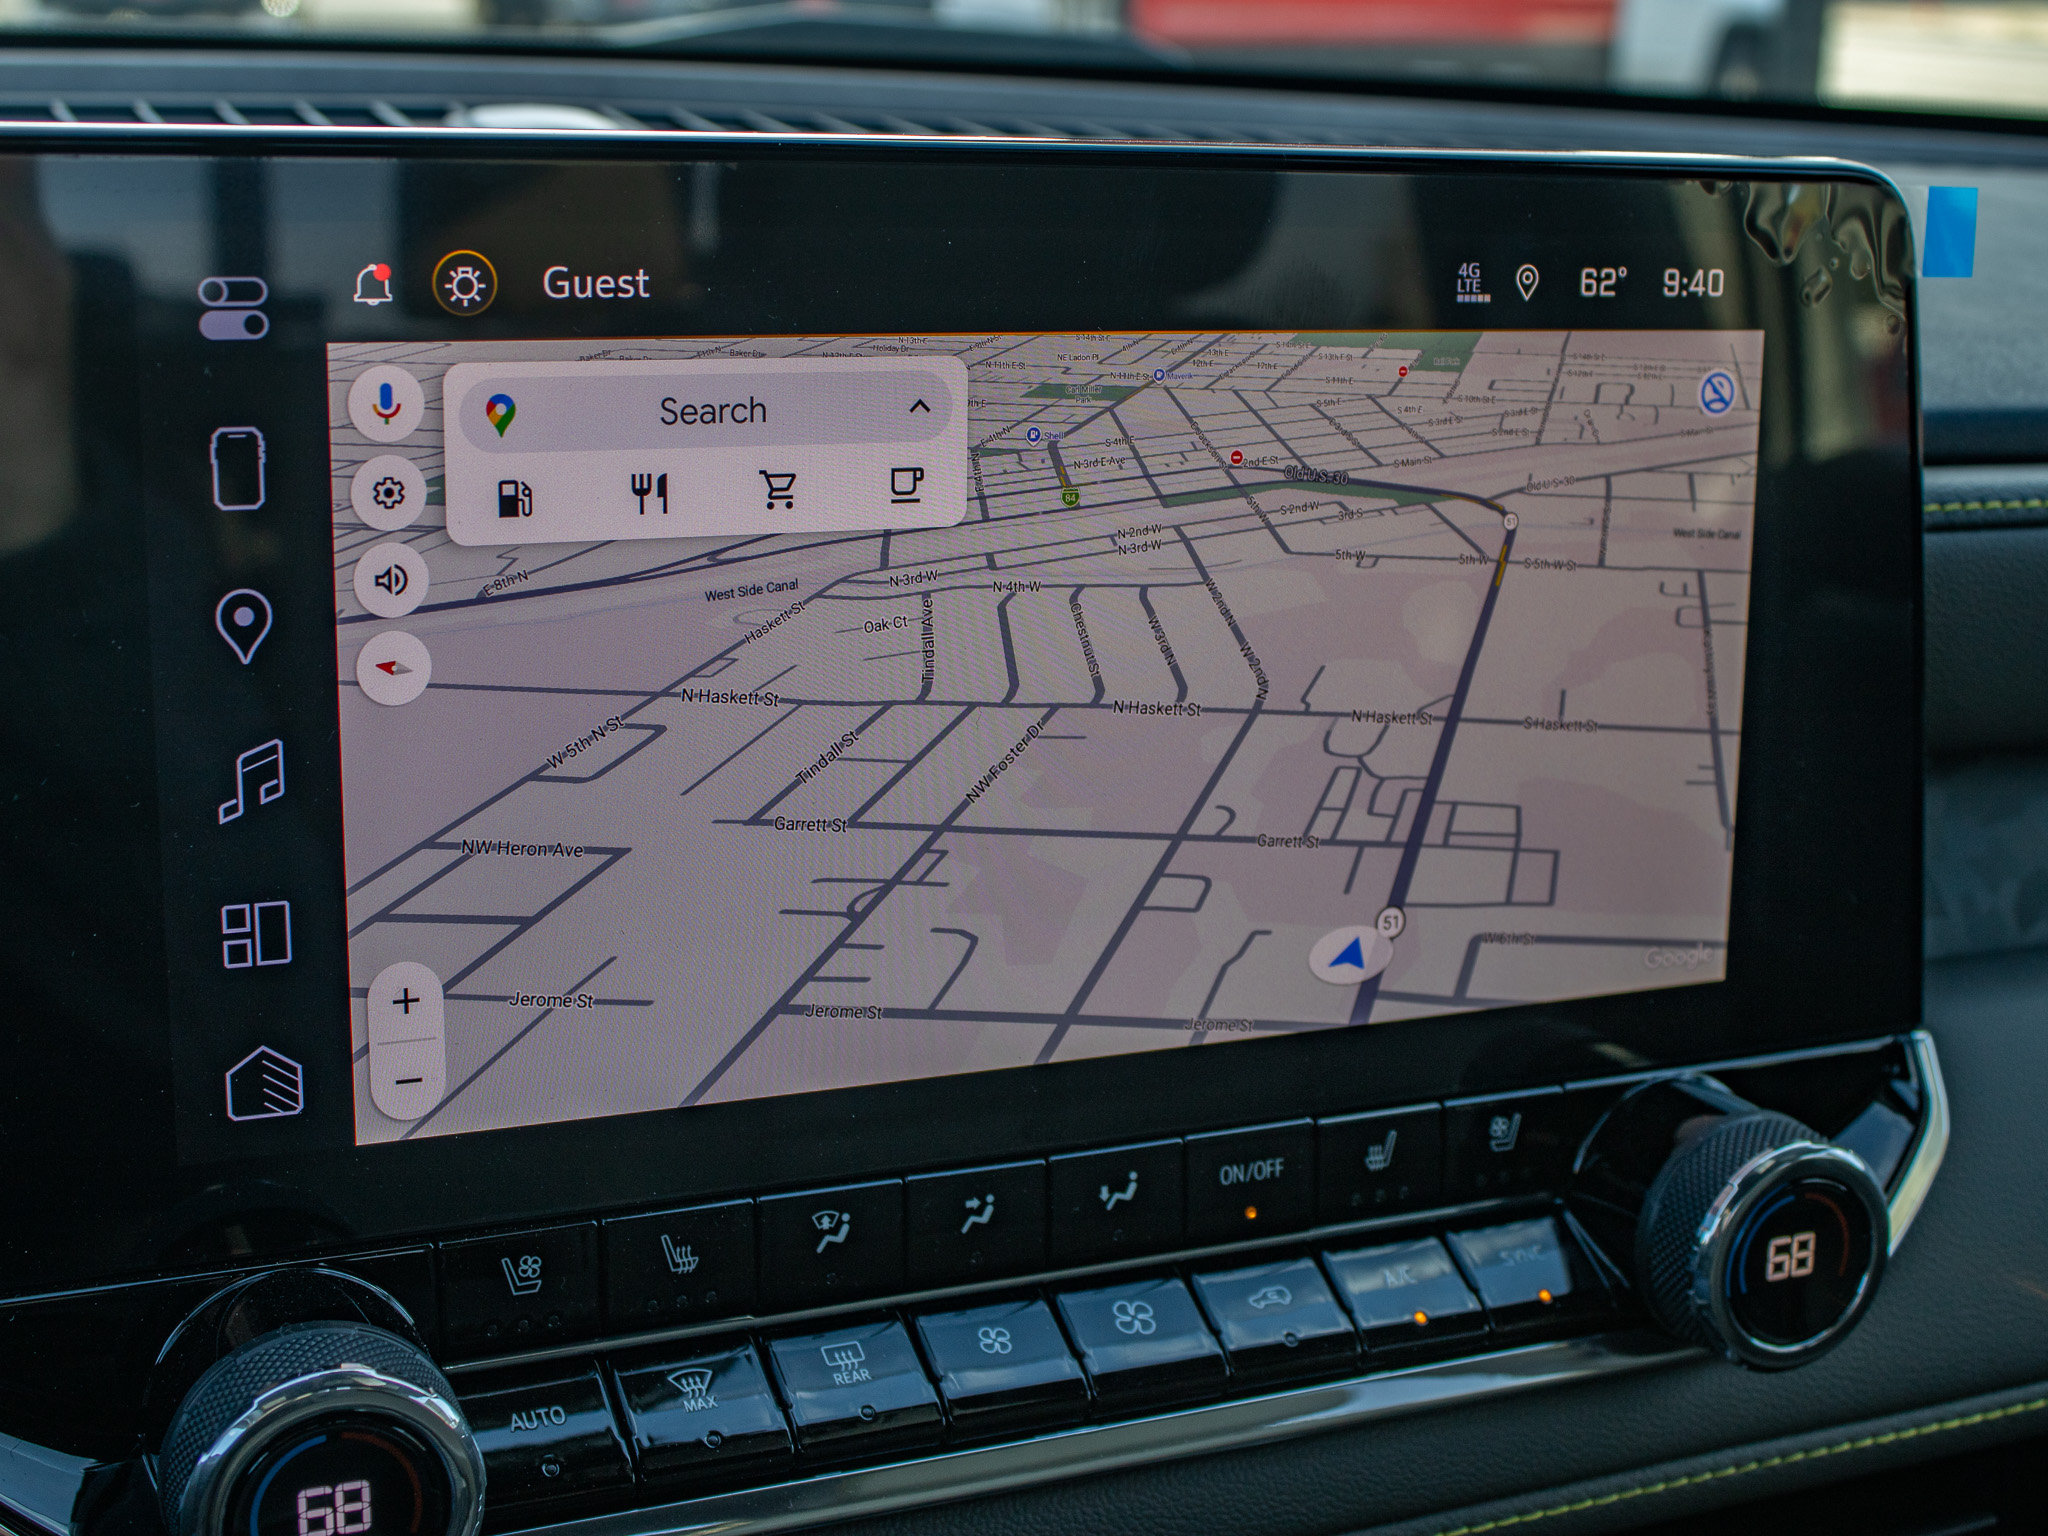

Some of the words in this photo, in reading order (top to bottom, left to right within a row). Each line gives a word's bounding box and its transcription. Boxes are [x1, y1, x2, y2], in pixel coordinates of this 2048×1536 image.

[1459, 263, 1480, 277] 4G
[543, 265, 651, 298] Guest
[1457, 278, 1481, 292] LTE
[1580, 266, 1628, 297] 62°
[1663, 268, 1725, 297] 9:40
[1066, 385, 1080, 394] Carl
[1081, 385, 1102, 394] Miller
[660, 396, 766, 425] Search
[1403, 405, 1416, 414] 4th
[1417, 405, 1423, 413] E
[981, 439, 988, 448] E
[987, 429, 1002, 443] 4th
[1002, 425, 1011, 434] N
[1044, 432, 1065, 440] Shell
[1105, 439, 1112, 448] S
[1114, 438, 1128, 447] 4th
[1129, 436, 1135, 445] E
[1073, 461, 1082, 469] N
[1083, 458, 1099, 469] 3rd
[1101, 457, 1107, 466] E
[1108, 455, 1127, 466] Ave
[1243, 458, 1260, 468] 2nd
[1262, 456, 1268, 466] E
[1270, 455, 1279, 465] St
[1394, 460, 1400, 469] S
[1401, 457, 1421, 468] Main
[1423, 456, 1433, 465] St
[1284, 465, 1307, 481] Old
[1308, 468, 1331, 484] U.S.
[1333, 471, 1349, 486] 30
[1065, 494, 1076, 503] 84
[1246, 496, 1263, 517] 5th
[1259, 512, 1270, 523] W
[1280, 505, 1287, 515] S
[1289, 503, 1307, 515] 2nd
[1309, 500, 1320, 511] W
[1338, 509, 1354, 521] 3rd
[1356, 508, 1364, 517] S
[1506, 517, 1517, 527] 51
[1118, 529, 1126, 540] N
[1130, 526, 1149, 538] 2nd
[1150, 523, 1163, 534] W
[1673, 528, 1697, 538] West
[1697, 528, 1716, 539] Side
[1118, 545, 1126, 555] N
[1130, 541, 1148, 554] 3rd
[1150, 539, 1163, 550] W
[1335, 550, 1352, 560] 5th
[1354, 551, 1366, 561] W
[1459, 555, 1476, 565] 5th
[1478, 556, 1490, 566] W
[1524, 559, 1532, 569] S
[1534, 559, 1550, 570] 5th
[1553, 560, 1565, 571] W
[1566, 560, 1577, 572] St
[485, 585, 494, 597] E
[493, 575, 516, 593] 8th
[517, 569, 530, 583] N
[890, 576, 900, 587] N
[903, 572, 923, 586] 3rd
[925, 569, 939, 581] W
[993, 581, 1003, 593] N
[1005, 580, 1025, 592] 4th
[1027, 581, 1042, 593] W
[705, 588, 735, 602] West
[738, 584, 764, 599] Side
[766, 578, 799, 595] Canal
[1205, 578, 1217, 592] W
[1212, 593, 1231, 615] 2nd
[1223, 614, 1236, 628] N
[921, 598, 934, 628] Ave
[744, 610, 792, 645] Haskett
[790, 600, 806, 616] St
[864, 618, 890, 634] Oak
[893, 615, 909, 629] Ct
[1148, 615, 1161, 631] W
[1070, 602, 1096, 665] Chestnut
[1088, 662, 1101, 678] St
[1154, 631, 1174, 654] 3rd
[921, 632, 935, 684] Tindall
[1239, 641, 1253, 659] W
[1165, 653, 1178, 667] N
[1248, 658, 1270, 686] 2nd
[681, 688, 694, 702] N
[698, 689, 759, 706] Haskett
[763, 691, 780, 708] St
[1255, 686, 1269, 701] N
[1113, 700, 1125, 714] N
[1128, 700, 1183, 716] Haskett
[1187, 702, 1201, 717] St
[1352, 709, 1362, 723] N
[1365, 709, 1417, 726] Haskett
[1420, 711, 1434, 726] St
[1524, 716, 1533, 730] S
[1535, 717, 1582, 732] Haskett
[1585, 719, 1599, 733] St
[546, 751, 564, 770] W
[565, 735, 592, 759] 5th
[591, 726, 607, 743] N
[606, 715, 625, 732] St
[795, 742, 843, 785] Tindall
[841, 730, 859, 748] St
[965, 775, 991, 804] NW
[988, 736, 1029, 781] Foster
[1026, 720, 1044, 740] Dr
[774, 816, 827, 832] Garrett
[831, 817, 848, 833] St
[462, 839, 492, 855] NW
[497, 840, 548, 857] Heron
[552, 842, 584, 858] Ave
[1257, 833, 1302, 848] Garrett
[1306, 835, 1321, 849] St
[1384, 915, 1399, 930] 51
[1645, 942, 1713, 970] Google
[509, 992, 572, 1008] Jerome
[576, 993, 594, 1009] St
[805, 1003, 863, 1019] Jerome
[867, 1005, 882, 1020] St
[1185, 1018, 1237, 1032] Jerome
[1240, 1019, 1254, 1032] St
[1219, 1157, 1285, 1186] ON/OFF
[1766, 1231, 1816, 1282] 68
[833, 1369, 871, 1386] REAR
[683, 1396, 719, 1413] MAX
[510, 1405, 567, 1433] AUTO
[298, 1479, 372, 1536] 68
